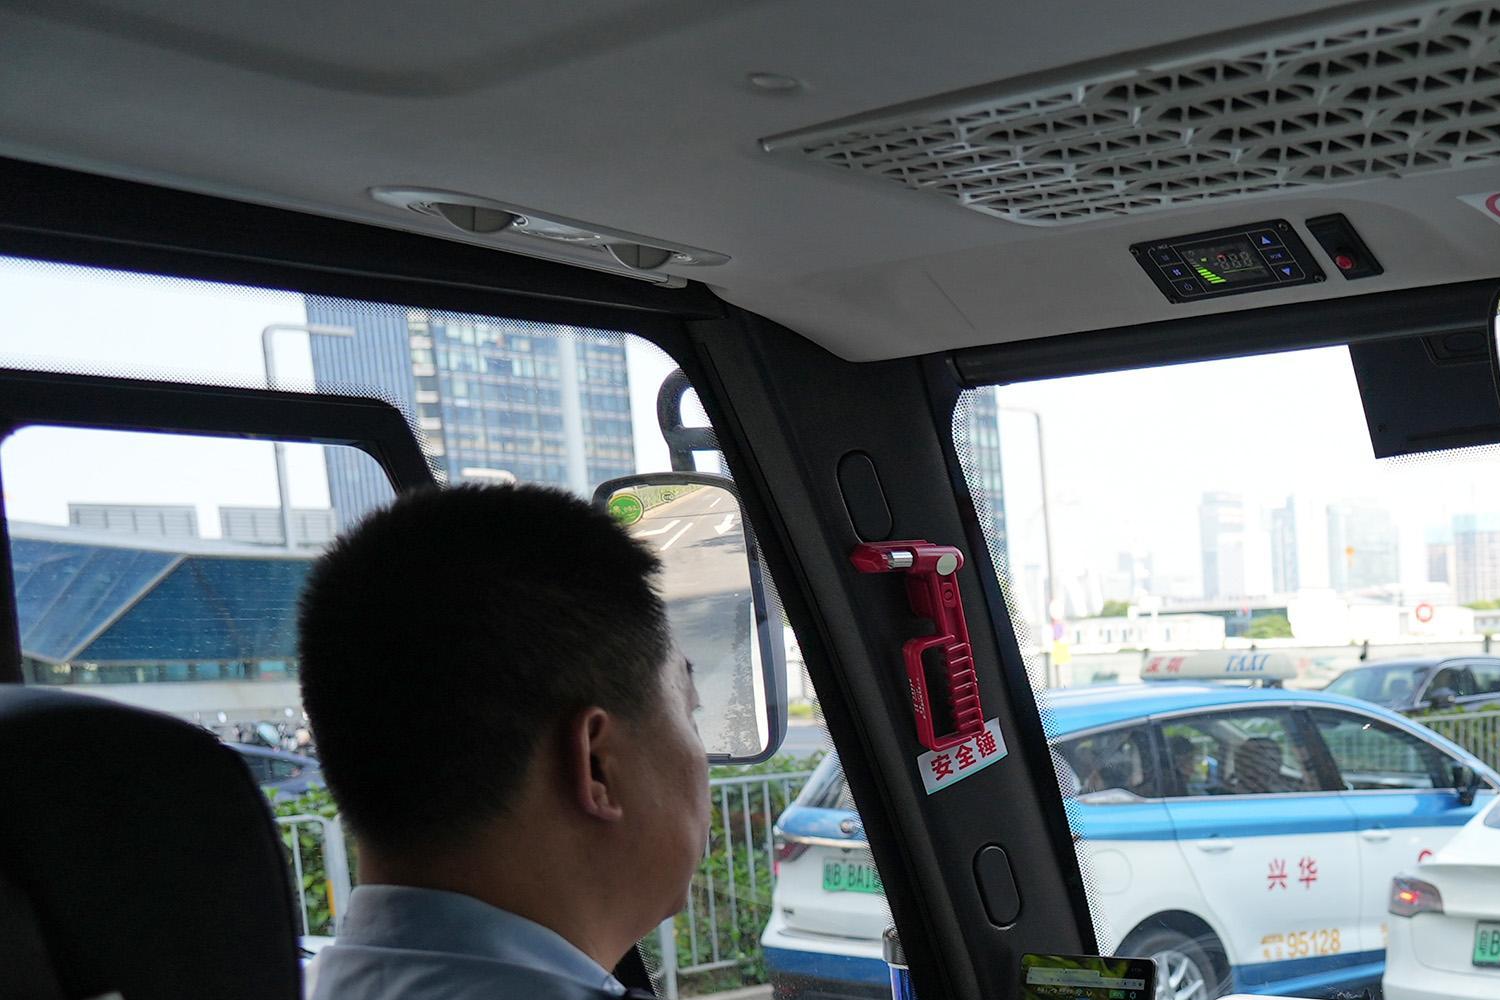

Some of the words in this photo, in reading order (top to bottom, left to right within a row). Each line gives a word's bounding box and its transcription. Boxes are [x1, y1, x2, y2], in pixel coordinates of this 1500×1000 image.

[1225, 653, 1272, 673] TAXI
[930, 730, 997, 781] 安全锤
[1267, 856, 1317, 891] 兴华
[1287, 928, 1341, 959] 95128
